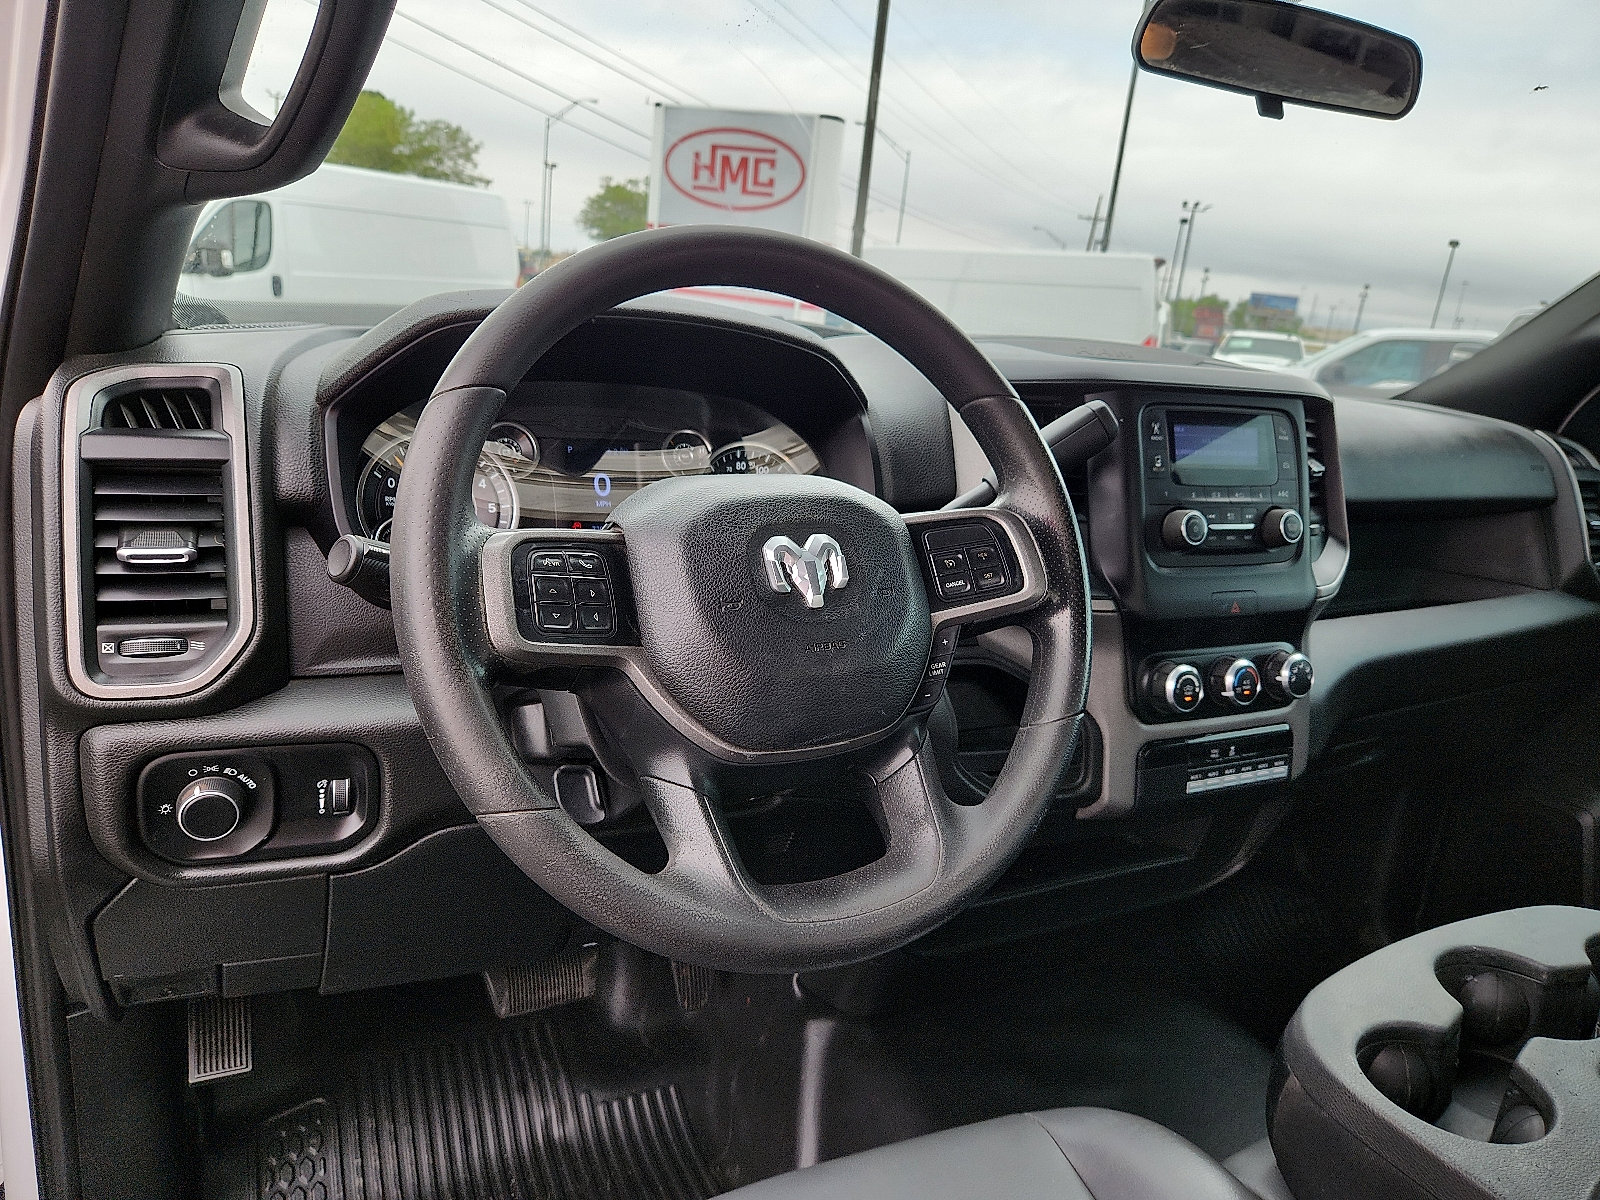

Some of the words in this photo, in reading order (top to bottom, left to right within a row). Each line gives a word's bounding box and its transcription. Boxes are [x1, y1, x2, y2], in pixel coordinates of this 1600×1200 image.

[692, 144, 777, 197] HMC
[735, 461, 747, 471] 80
[755, 466, 769, 475] 100
[387, 477, 396, 489] 0
[478, 478, 487, 489] 4
[593, 472, 611, 497] 0
[487, 503, 497, 513] 5
[595, 500, 612, 508] MPH
[945, 579, 966, 588] CANCEL
[804, 640, 848, 654] AIRBAG
[930, 661, 947, 670] GEAR
[928, 668, 944, 677] LIMIT
[237, 773, 257, 790] AUTO
